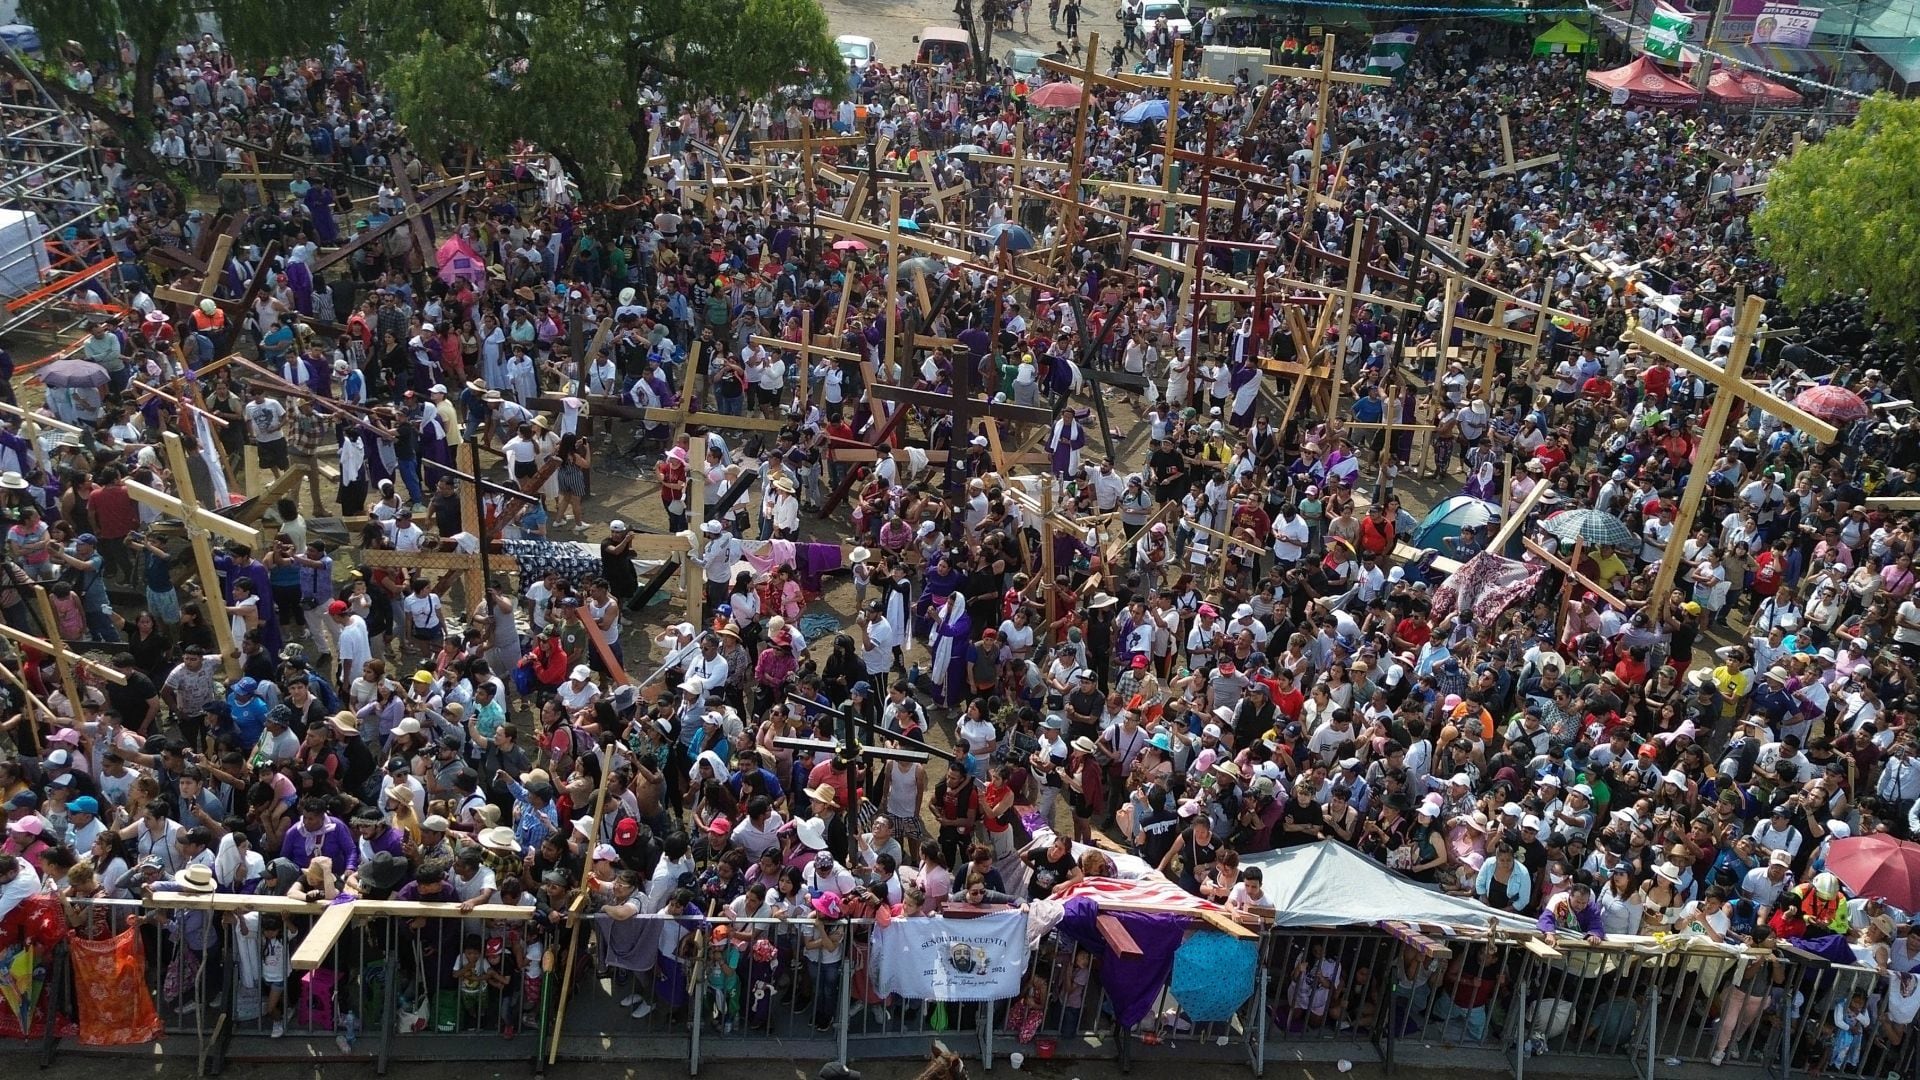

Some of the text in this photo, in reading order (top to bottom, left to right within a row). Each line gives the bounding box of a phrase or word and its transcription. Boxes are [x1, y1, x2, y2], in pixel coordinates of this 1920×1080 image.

[921, 935, 948, 950] SEÑOR
[961, 935, 973, 943] LA
[974, 935, 1007, 948] CUEVITA
[923, 968, 938, 976] 2023
